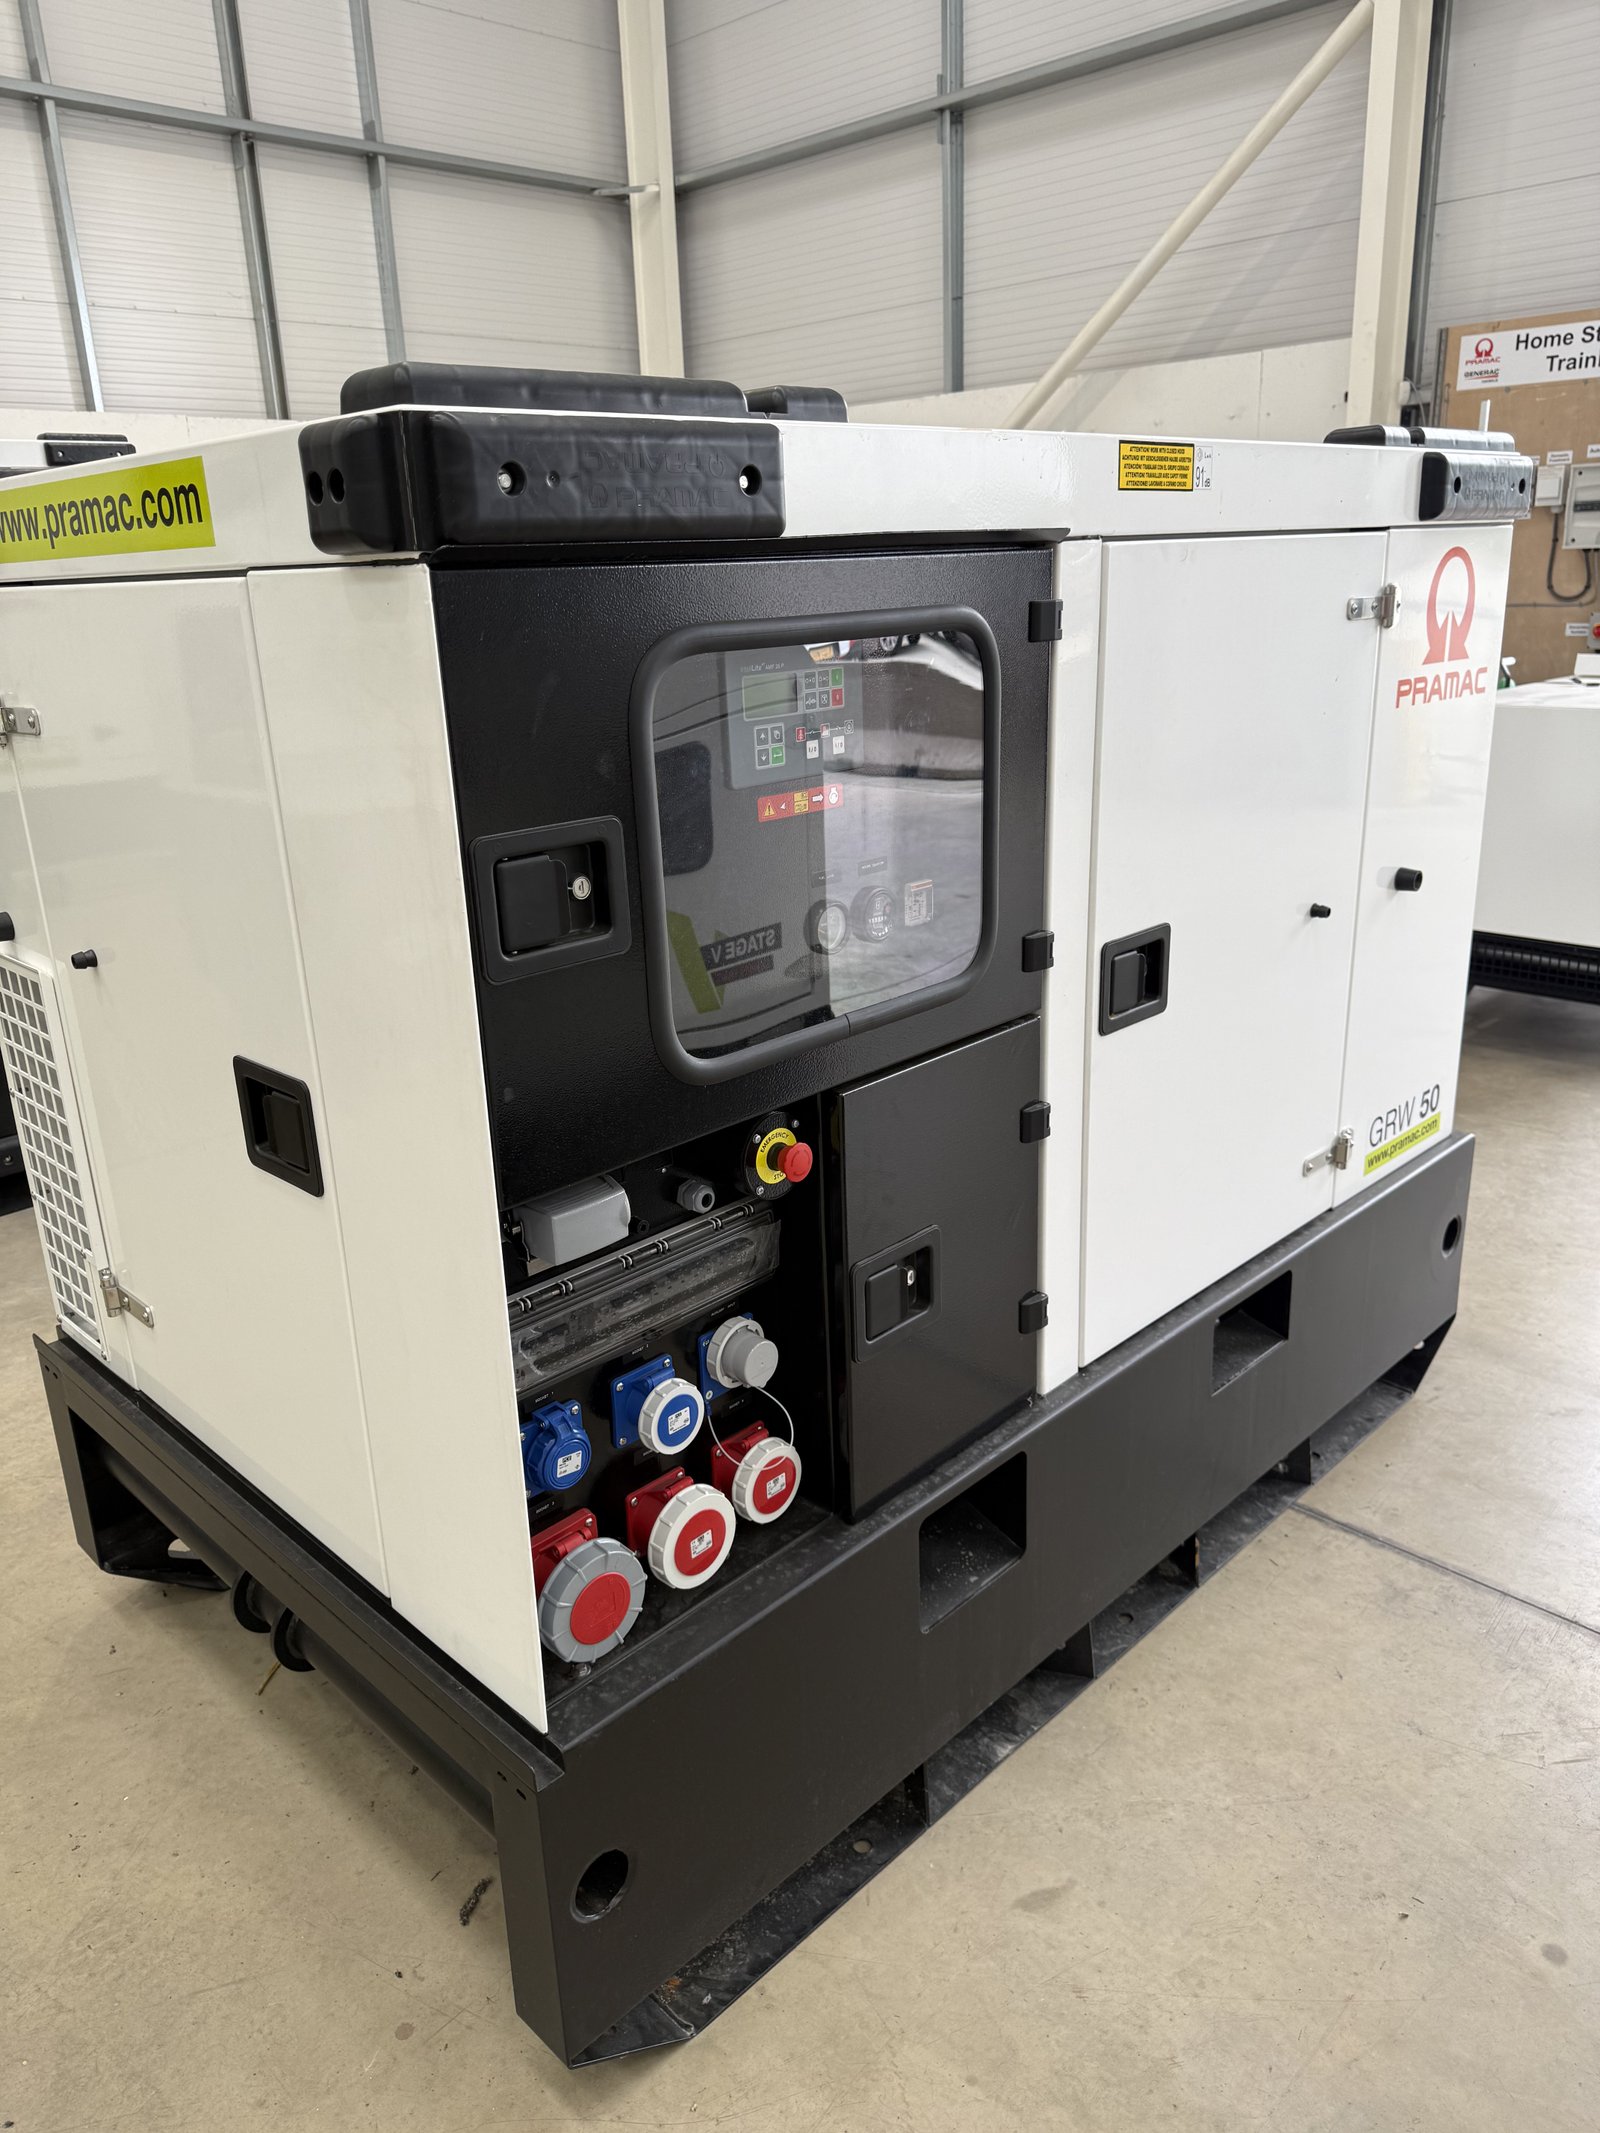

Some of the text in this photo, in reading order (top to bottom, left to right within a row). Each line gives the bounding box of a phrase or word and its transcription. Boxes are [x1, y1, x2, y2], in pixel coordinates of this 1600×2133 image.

[1515, 332, 1574, 351] Home
[1464, 368, 1500, 378] GENERAC
[1195, 466, 1204, 488] 91
[1396, 666, 1488, 708] PRAMAC
[1370, 1083, 1440, 1147] GRW 50
[760, 1132, 789, 1153] EMERGENCY
[1367, 1118, 1438, 1168] www.pramac.com
[773, 1171, 784, 1181] STO
